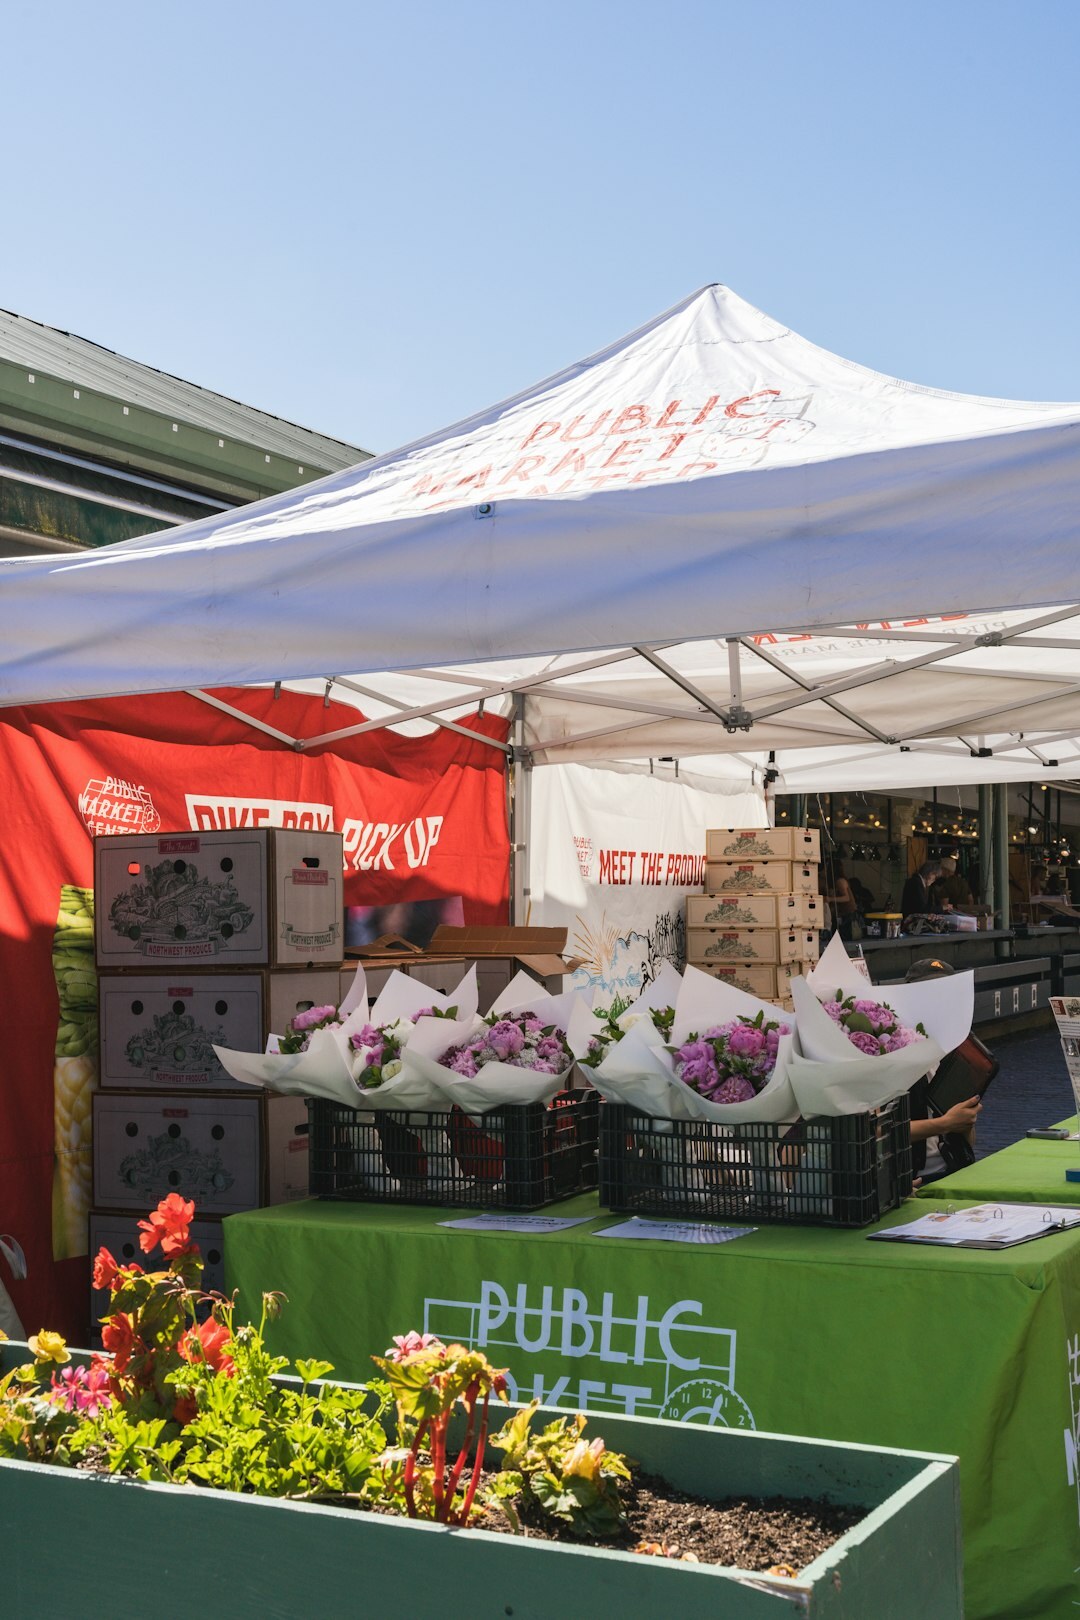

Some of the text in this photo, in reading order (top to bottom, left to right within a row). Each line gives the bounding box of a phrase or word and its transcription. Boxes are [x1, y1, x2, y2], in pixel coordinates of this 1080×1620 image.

[519, 389, 781, 450] PUBLIC
[405, 431, 702, 496] MARKET
[102, 776, 148, 803] PUBLIC
[78, 793, 143, 824] MARKET
[343, 817, 406, 871] PICK
[404, 816, 444, 869] UP
[599, 849, 707, 886] MEET THE PRODUC
[148, 943, 213, 956] NORTHWEST PRODUCE
[314, 933, 332, 945] PRODUCE
[477, 1280, 703, 1371] PUBLIC
[702, 1387, 712, 1399] 12
[669, 1407, 679, 1418] 10
[738, 1415, 745, 1425] 2
